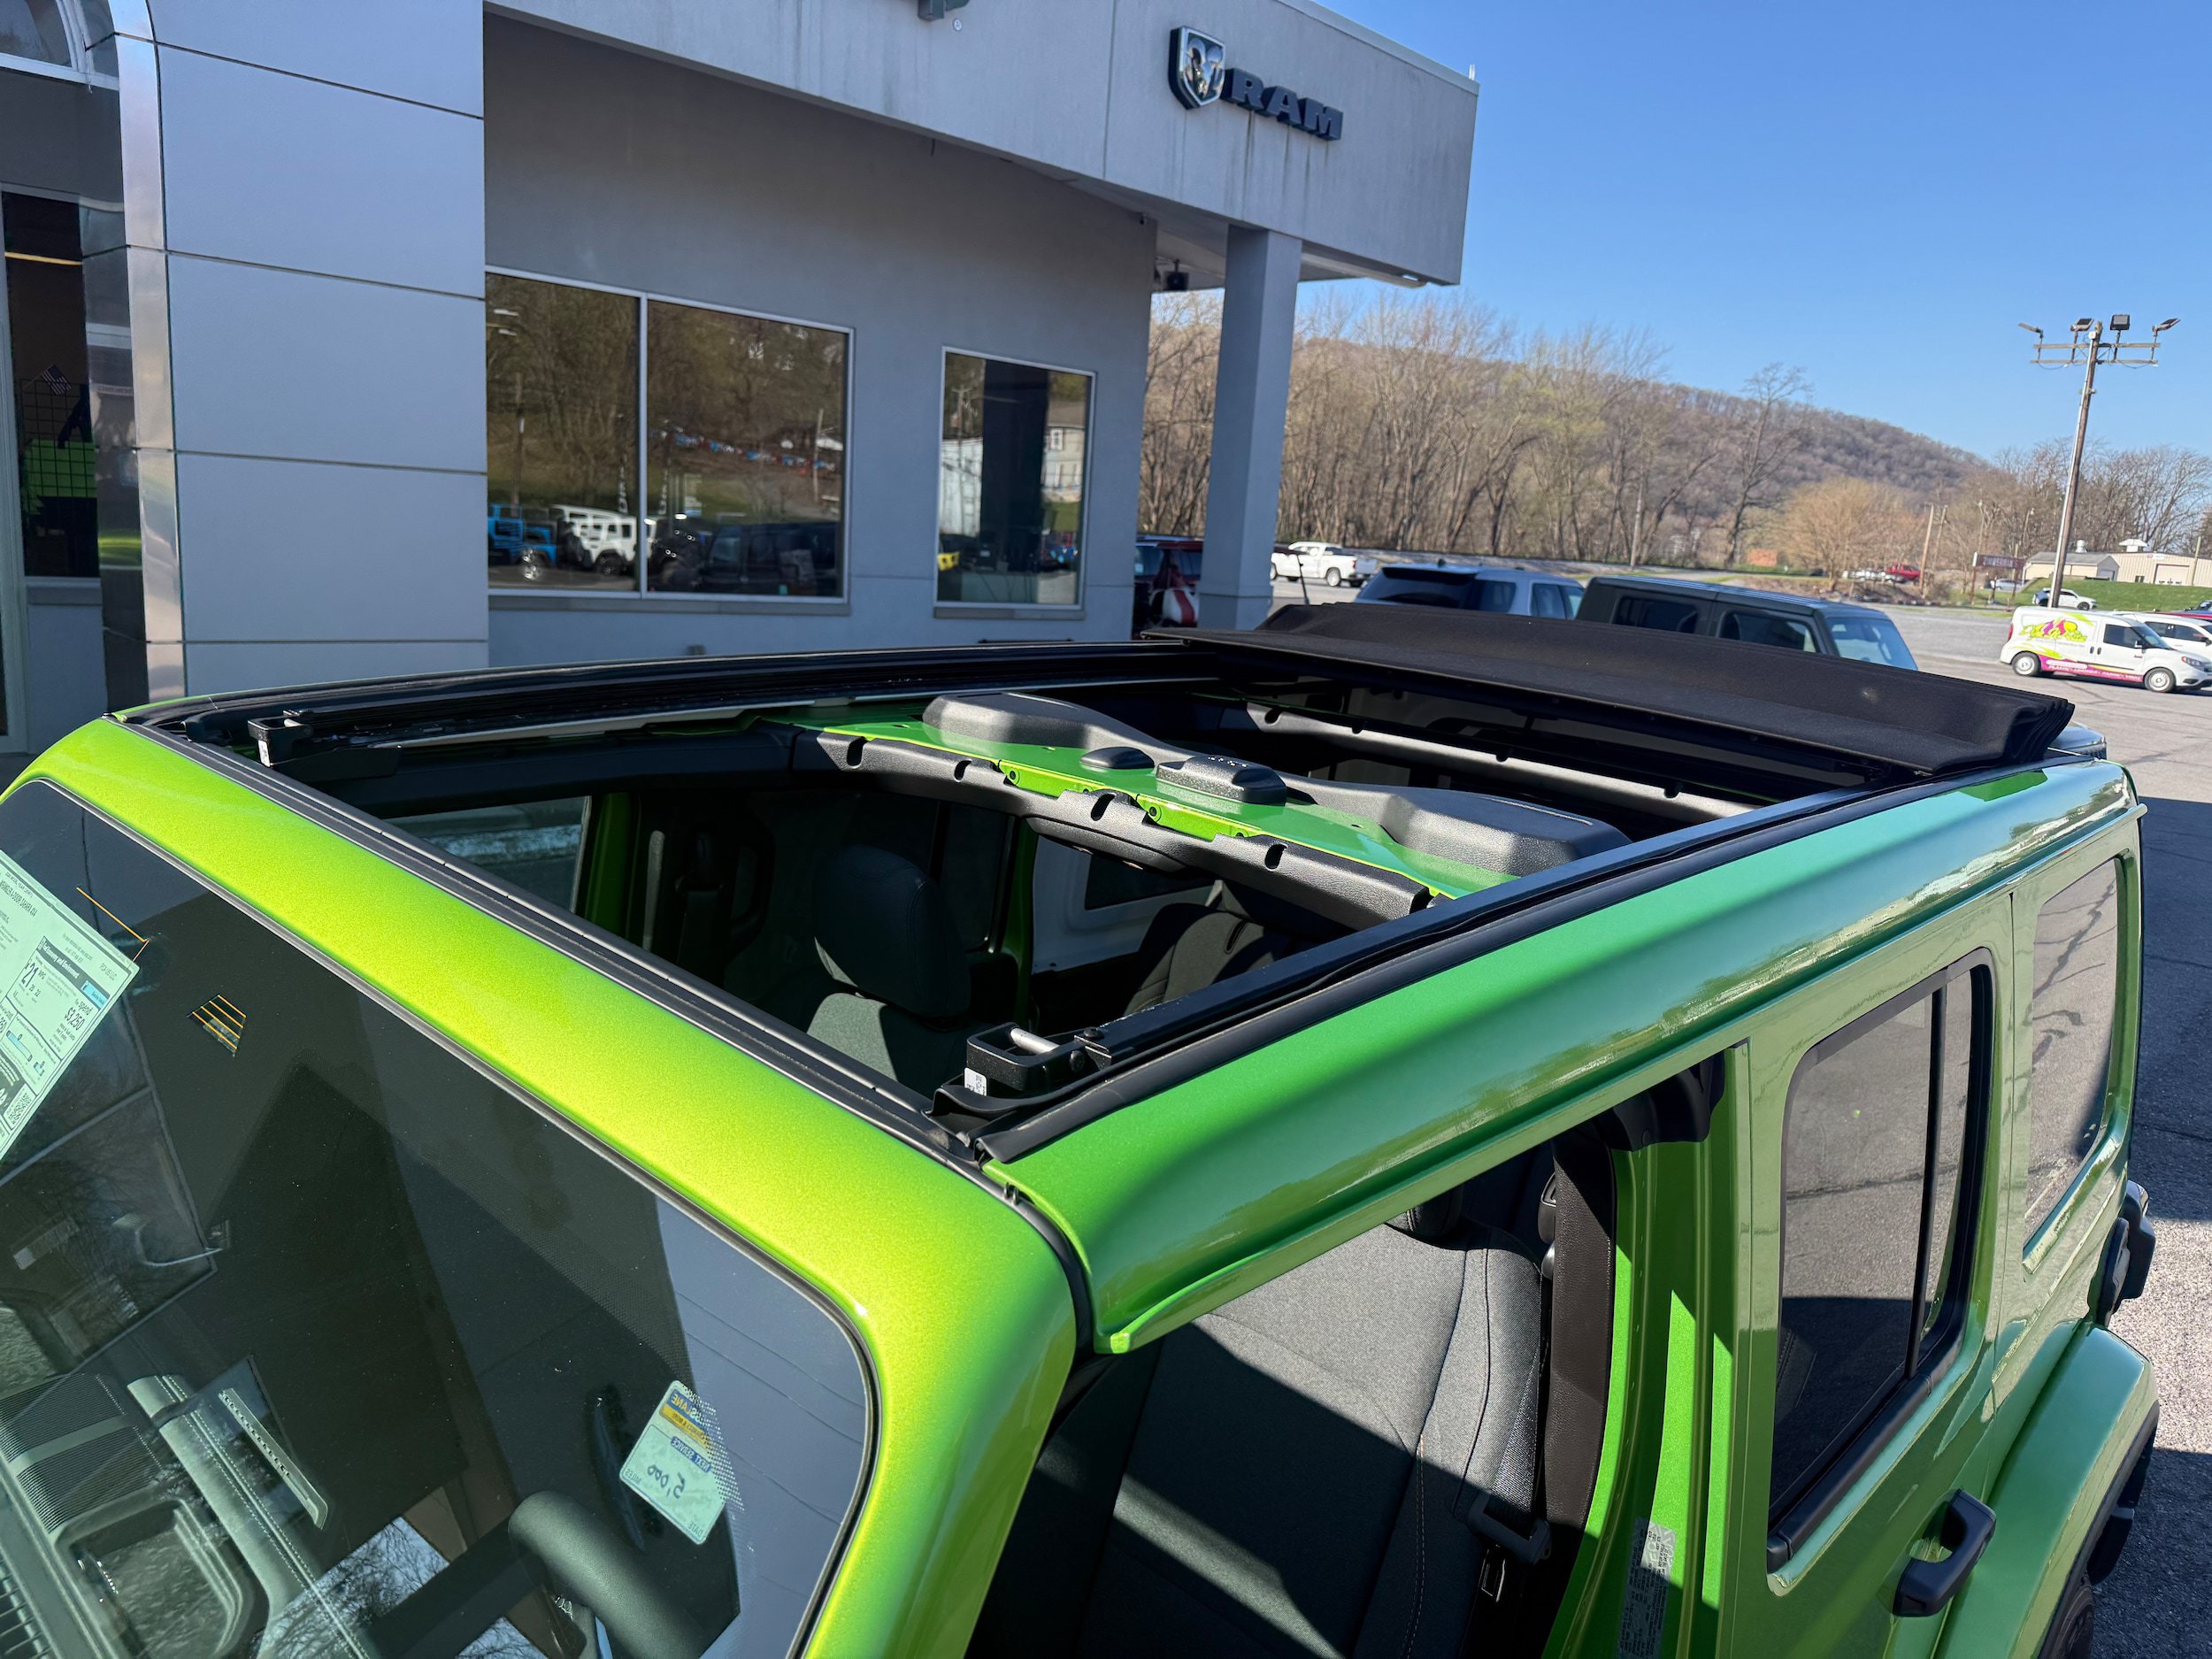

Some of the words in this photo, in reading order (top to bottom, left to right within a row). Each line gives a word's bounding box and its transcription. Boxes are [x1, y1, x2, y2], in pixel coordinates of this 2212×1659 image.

[1222, 67, 1344, 142] RAM
[65, 1006, 86, 1032] $3,250
[79, 1002, 93, 1015] spend
